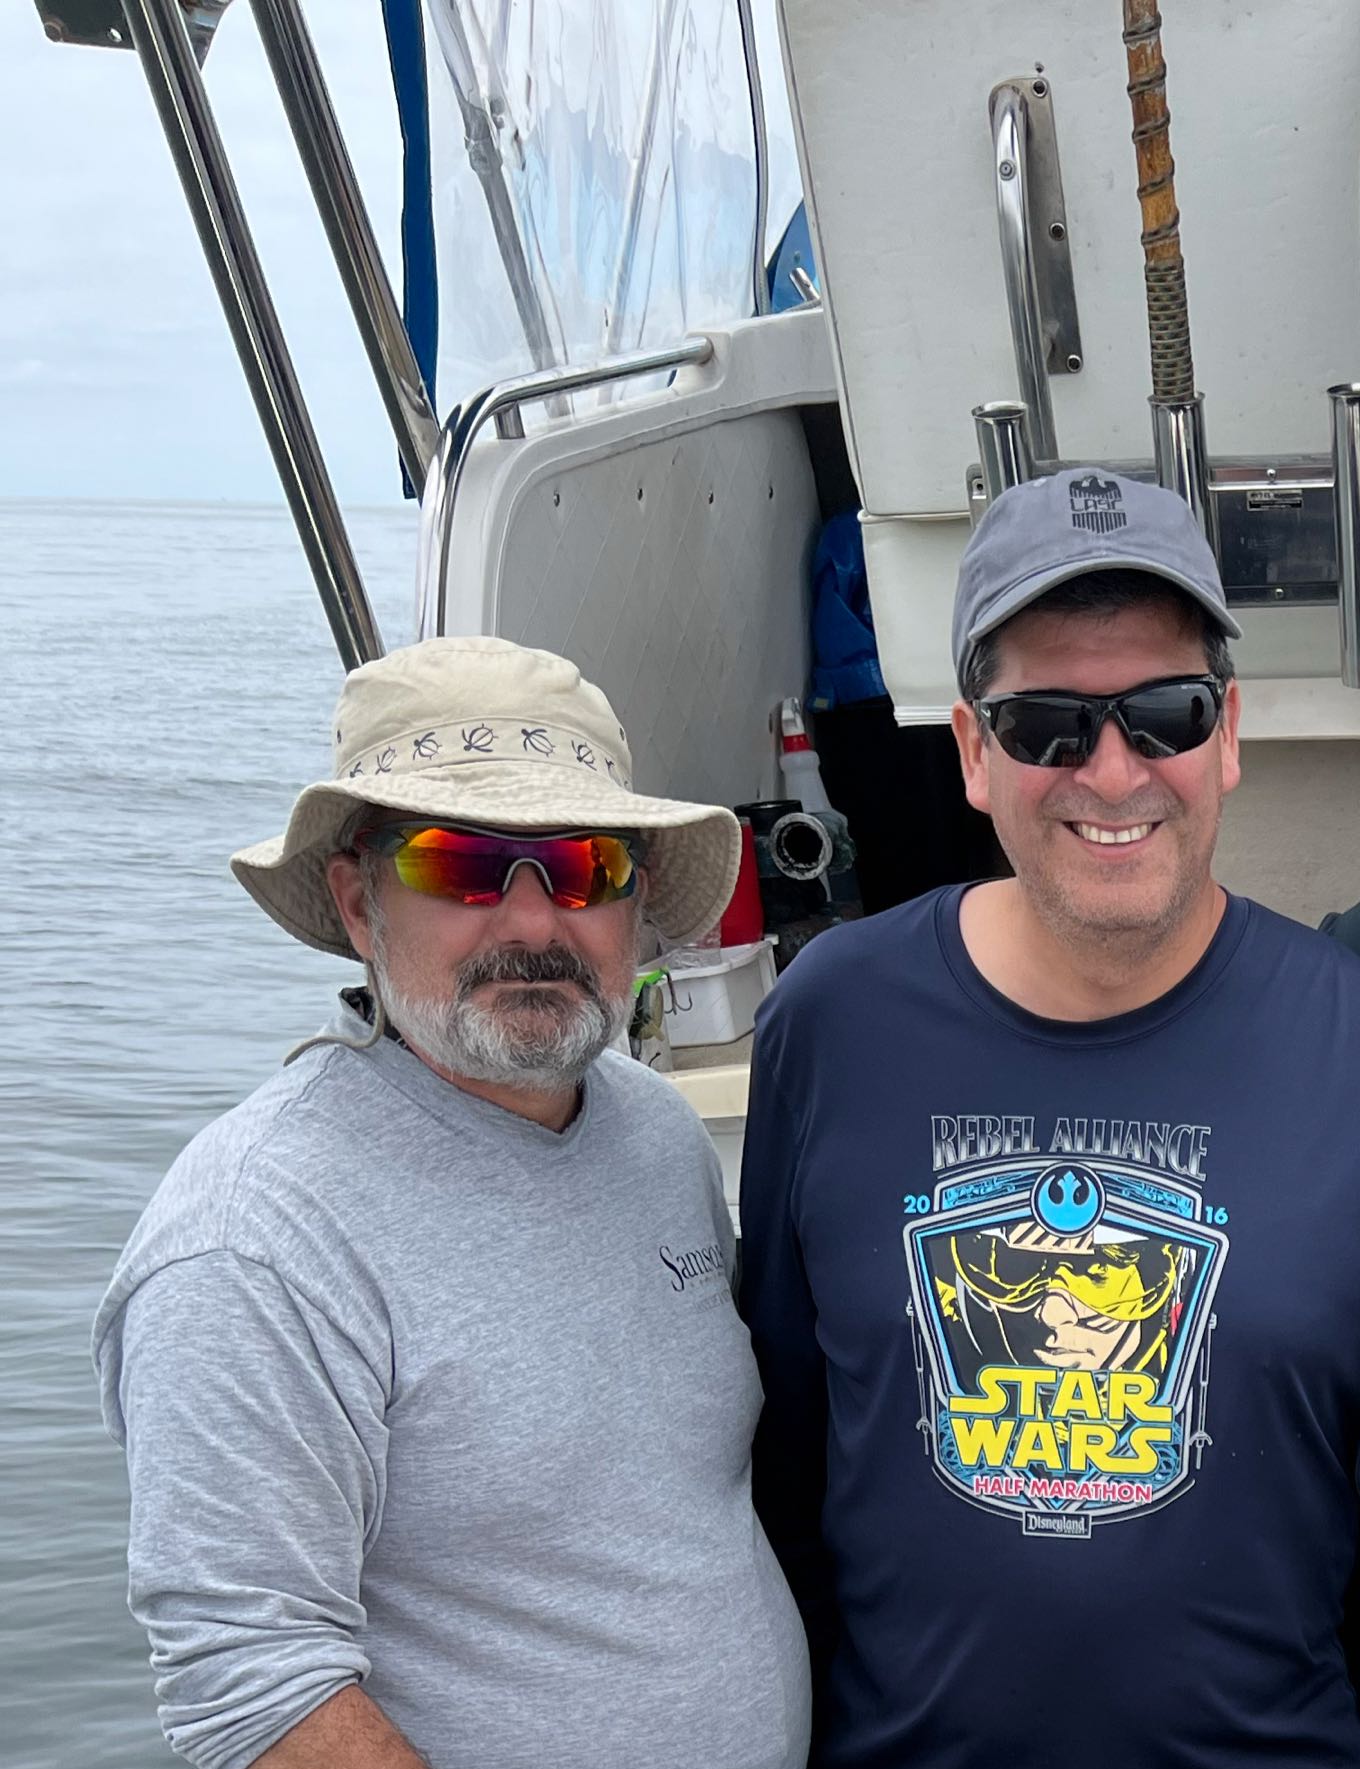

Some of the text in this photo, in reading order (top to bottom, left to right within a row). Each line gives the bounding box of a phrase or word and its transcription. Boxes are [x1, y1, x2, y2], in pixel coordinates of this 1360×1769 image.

[931, 1115, 1211, 1182] REBEL ALLIANCE
[903, 1195, 931, 1214] 20
[1204, 1206, 1229, 1225] 16
[949, 1366, 1174, 1424] STAR
[949, 1416, 1174, 1475] WARS
[974, 1476, 1153, 1504] HALF MARATHON
[1026, 1513, 1086, 1534] Disneyland
